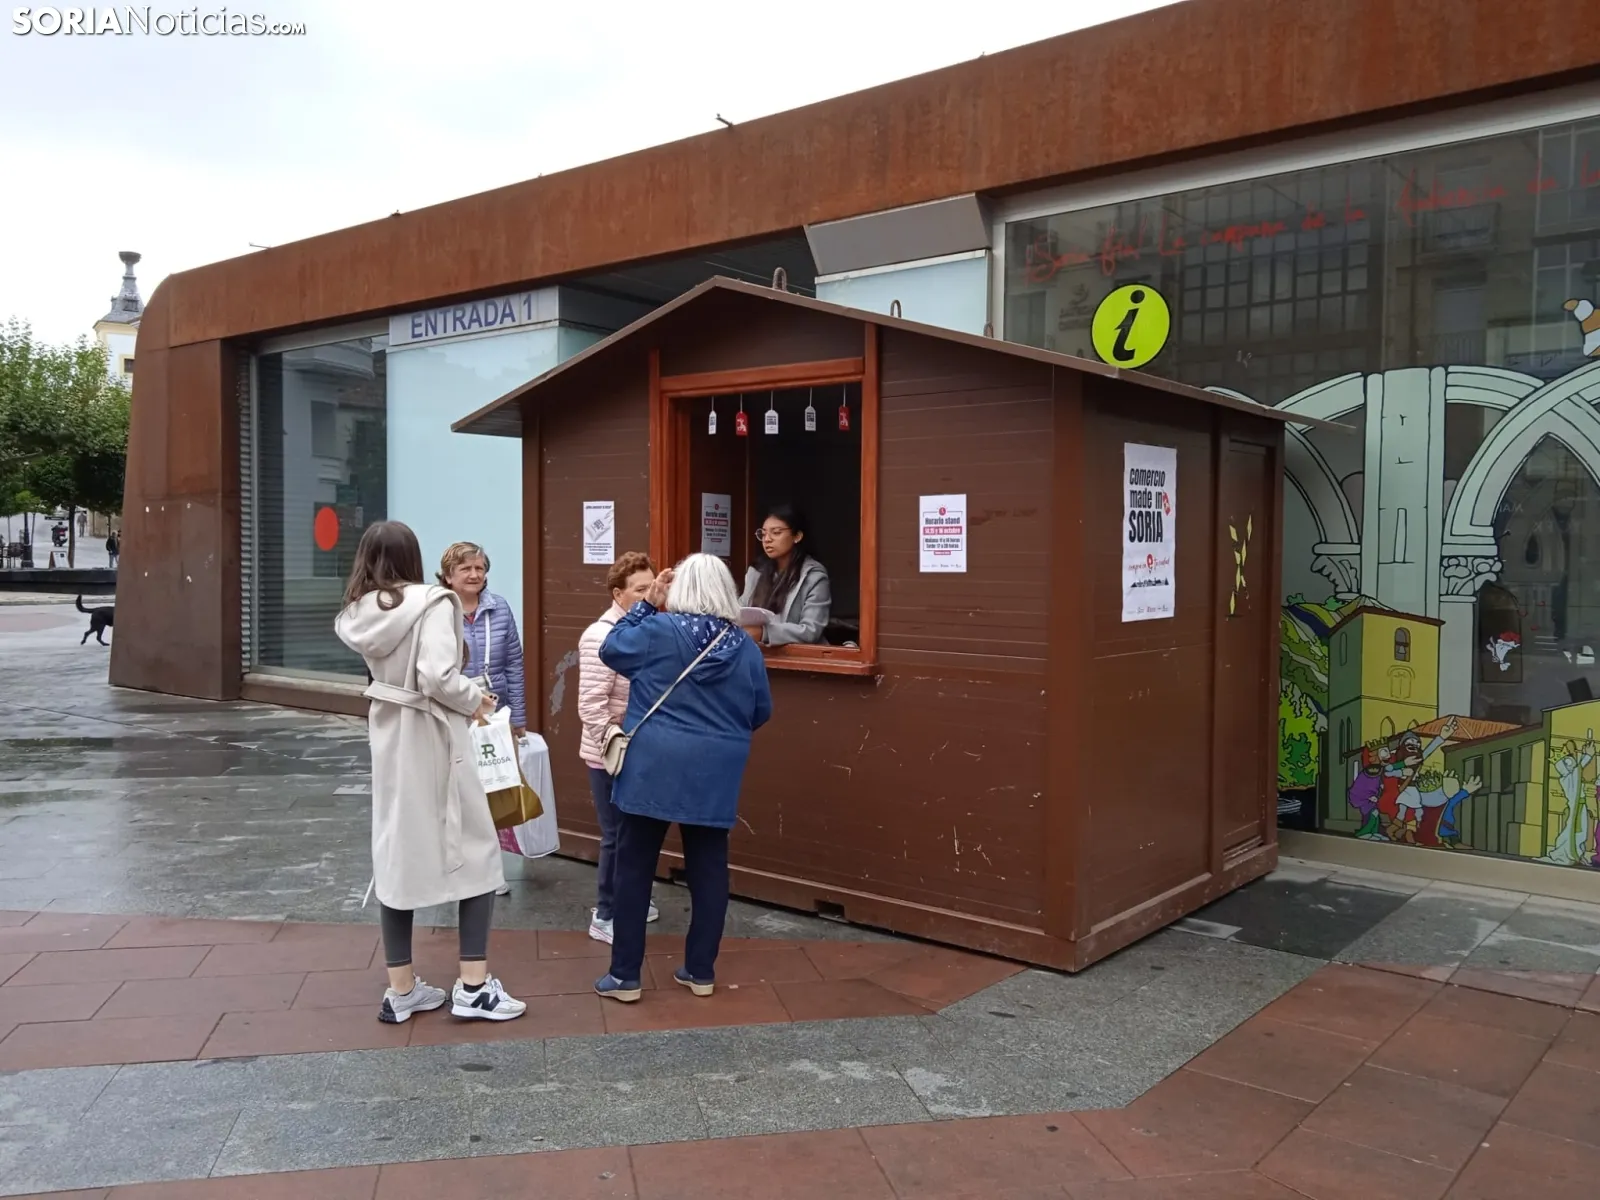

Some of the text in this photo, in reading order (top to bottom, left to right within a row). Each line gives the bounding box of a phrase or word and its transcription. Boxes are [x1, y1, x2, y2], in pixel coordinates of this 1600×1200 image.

[411, 293, 532, 339] ENTRADA 1
[1129, 467, 1166, 486] comercio
[1129, 487, 1163, 509] made in
[925, 516, 960, 525] Horario stand
[1128, 509, 1164, 544] SORIA
[478, 755, 512, 767] RASCOSA
